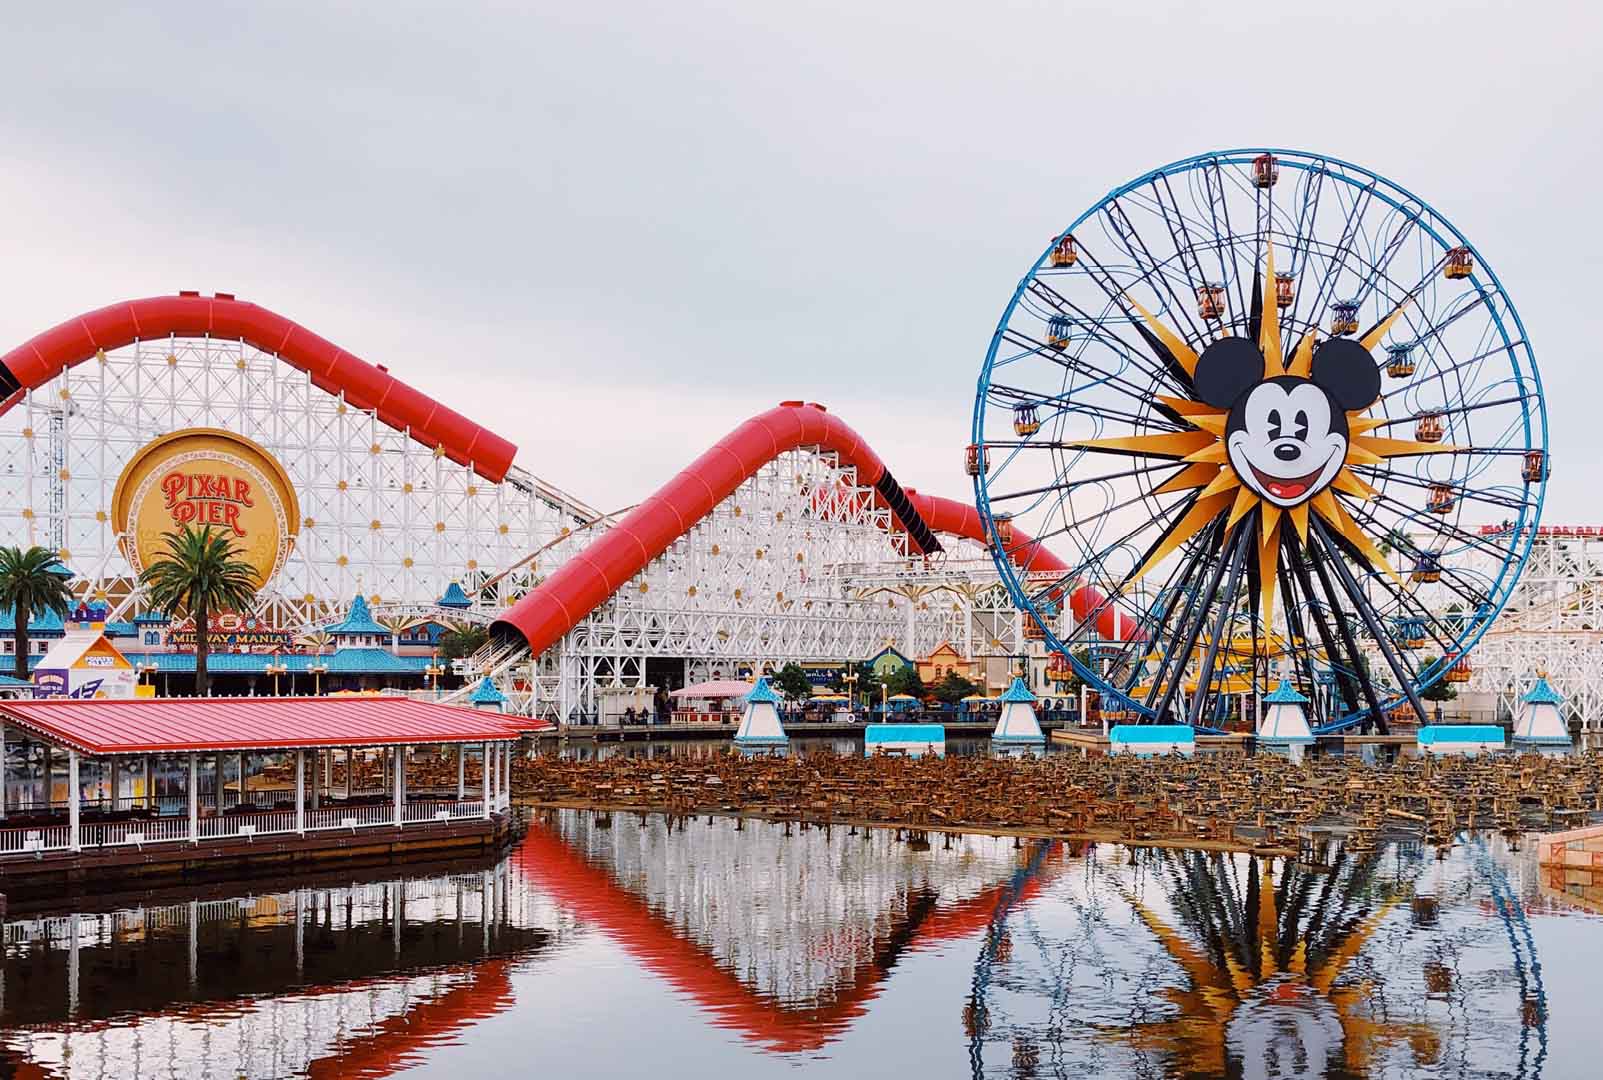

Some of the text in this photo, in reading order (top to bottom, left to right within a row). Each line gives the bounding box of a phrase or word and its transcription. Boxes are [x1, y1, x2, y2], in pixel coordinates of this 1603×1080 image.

[161, 472, 254, 508] PIXAR
[171, 501, 247, 537] PIER
[237, 634, 289, 643] MANIA!
